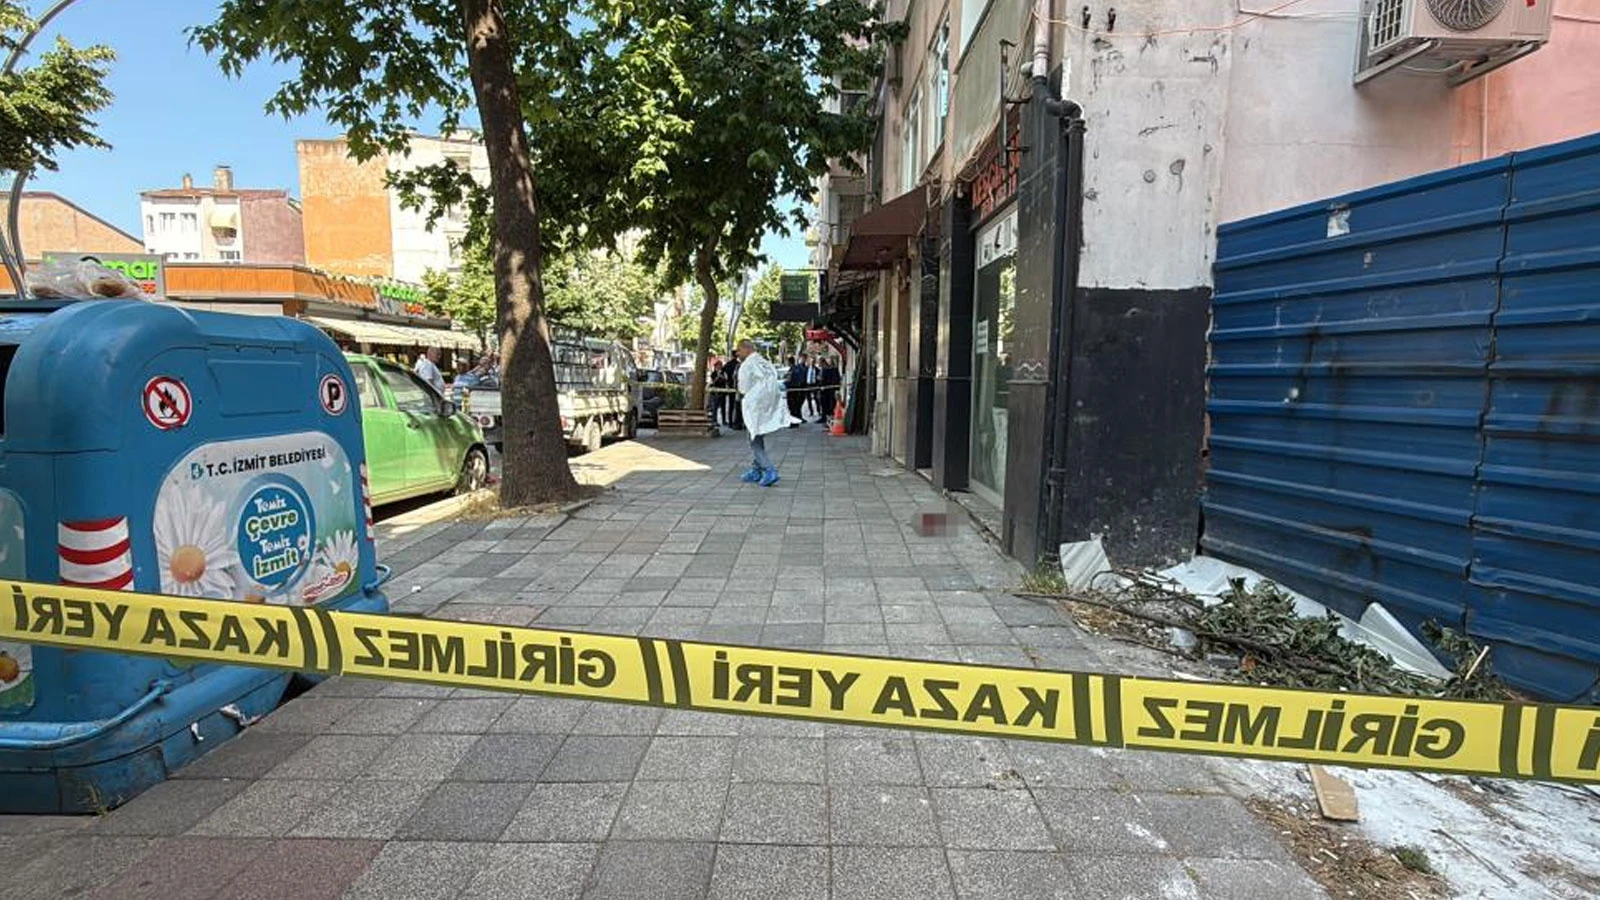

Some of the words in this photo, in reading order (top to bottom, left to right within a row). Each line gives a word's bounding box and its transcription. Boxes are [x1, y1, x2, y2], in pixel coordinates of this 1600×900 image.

[327, 382, 341, 409] P
[206, 462, 232, 477] T.C.
[233, 453, 267, 473] İZMİT
[269, 445, 325, 467] BELEDİYESİ
[246, 509, 298, 542] Çevre
